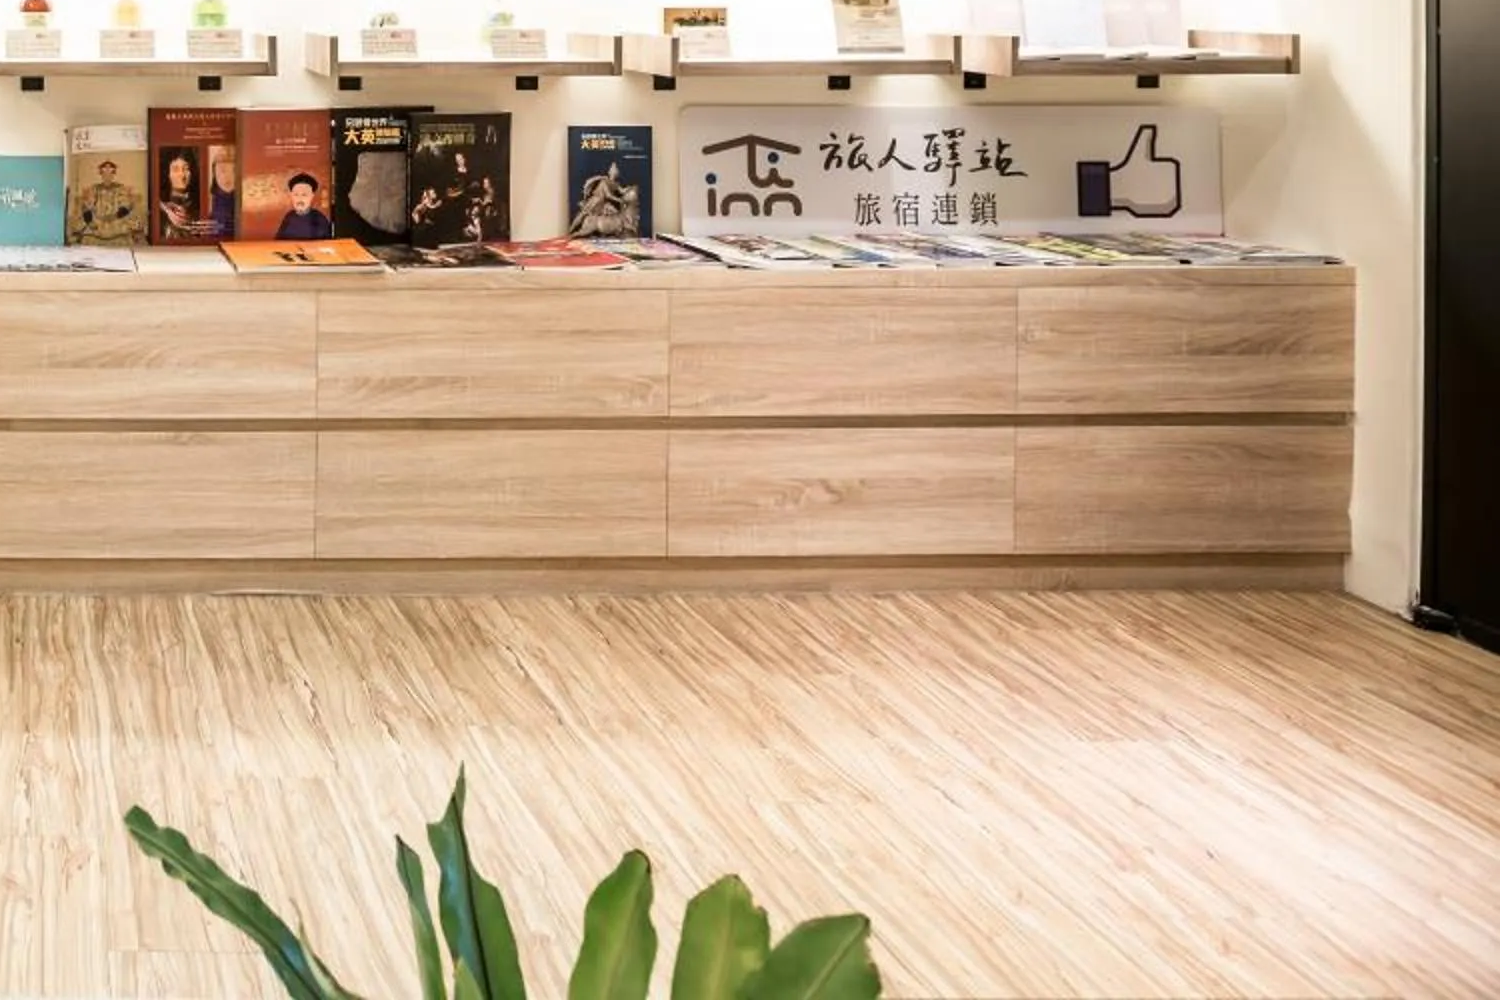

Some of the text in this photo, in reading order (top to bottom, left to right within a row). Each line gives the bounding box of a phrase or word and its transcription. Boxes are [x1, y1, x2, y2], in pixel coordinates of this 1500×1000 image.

[819, 127, 1028, 188] 旅人驛站
[853, 191, 999, 227] 旅宿連鎖
